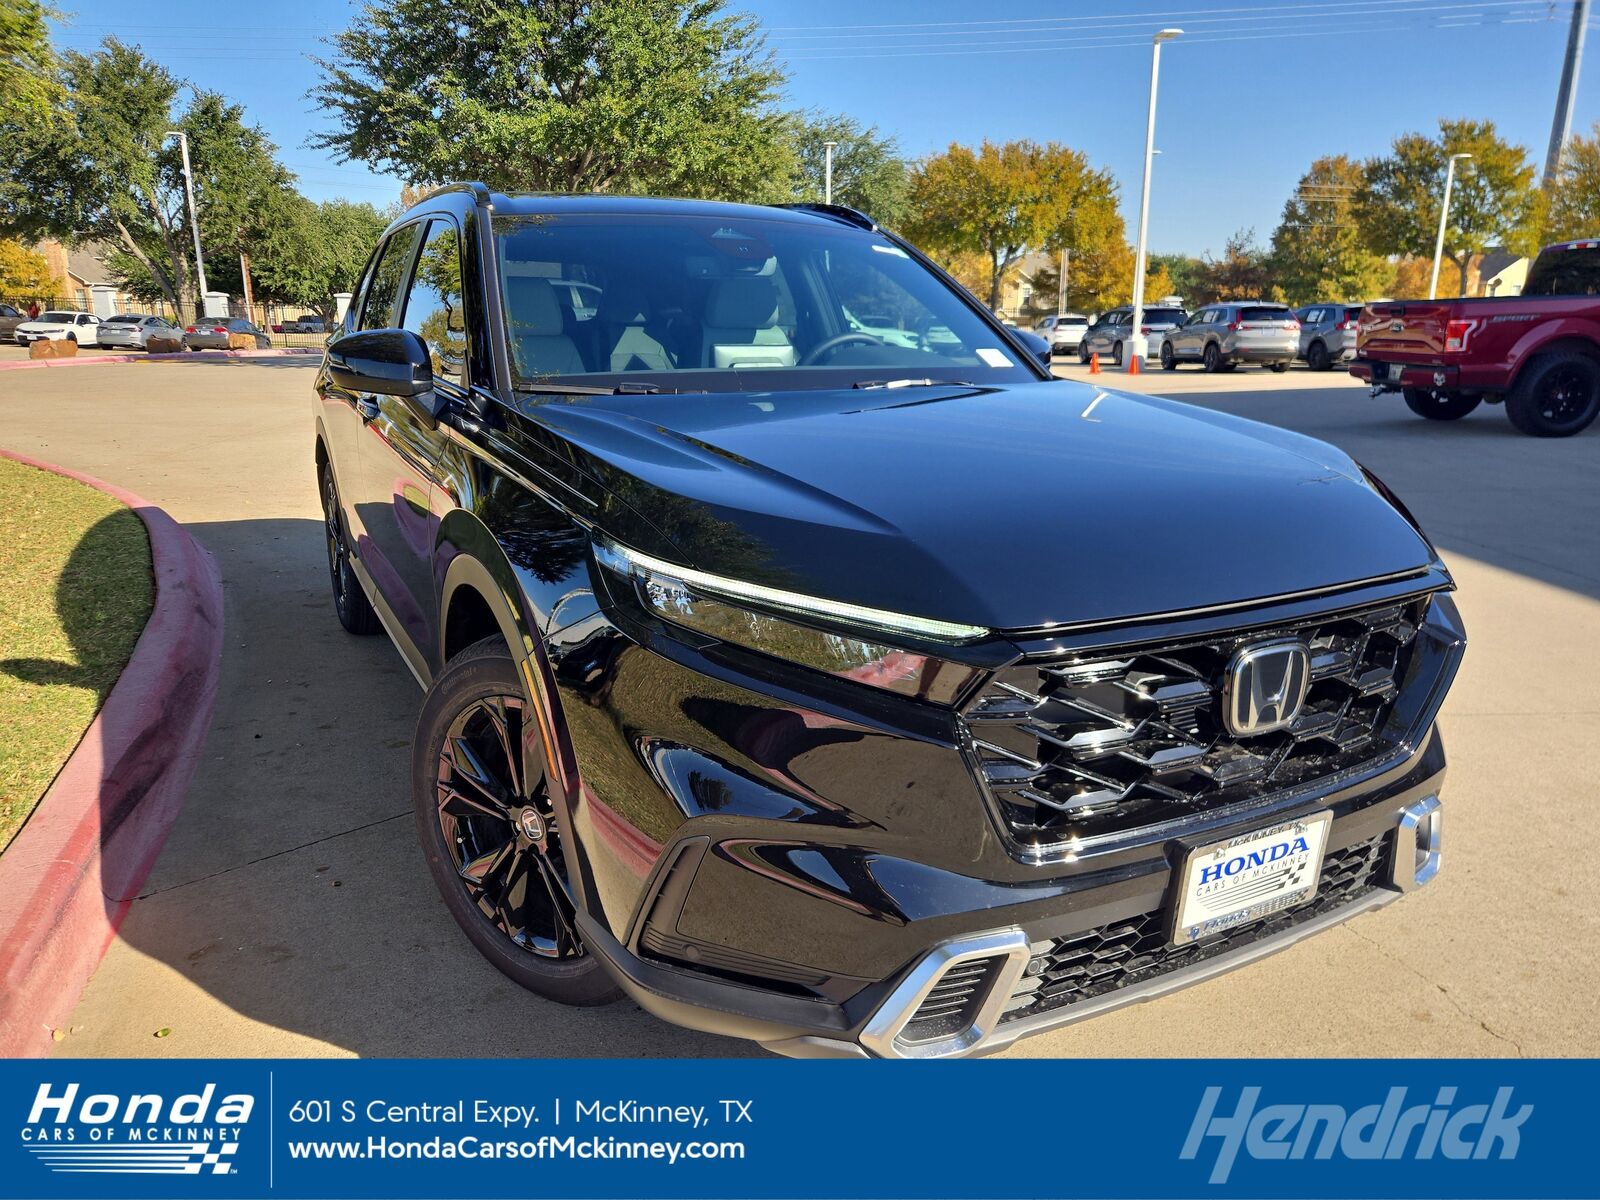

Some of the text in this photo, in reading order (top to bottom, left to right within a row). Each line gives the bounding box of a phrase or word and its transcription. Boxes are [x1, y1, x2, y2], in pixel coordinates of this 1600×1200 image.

[1196, 853, 1310, 897] CARS OF MCKINNEY
[1198, 836, 1310, 886] HONDA
